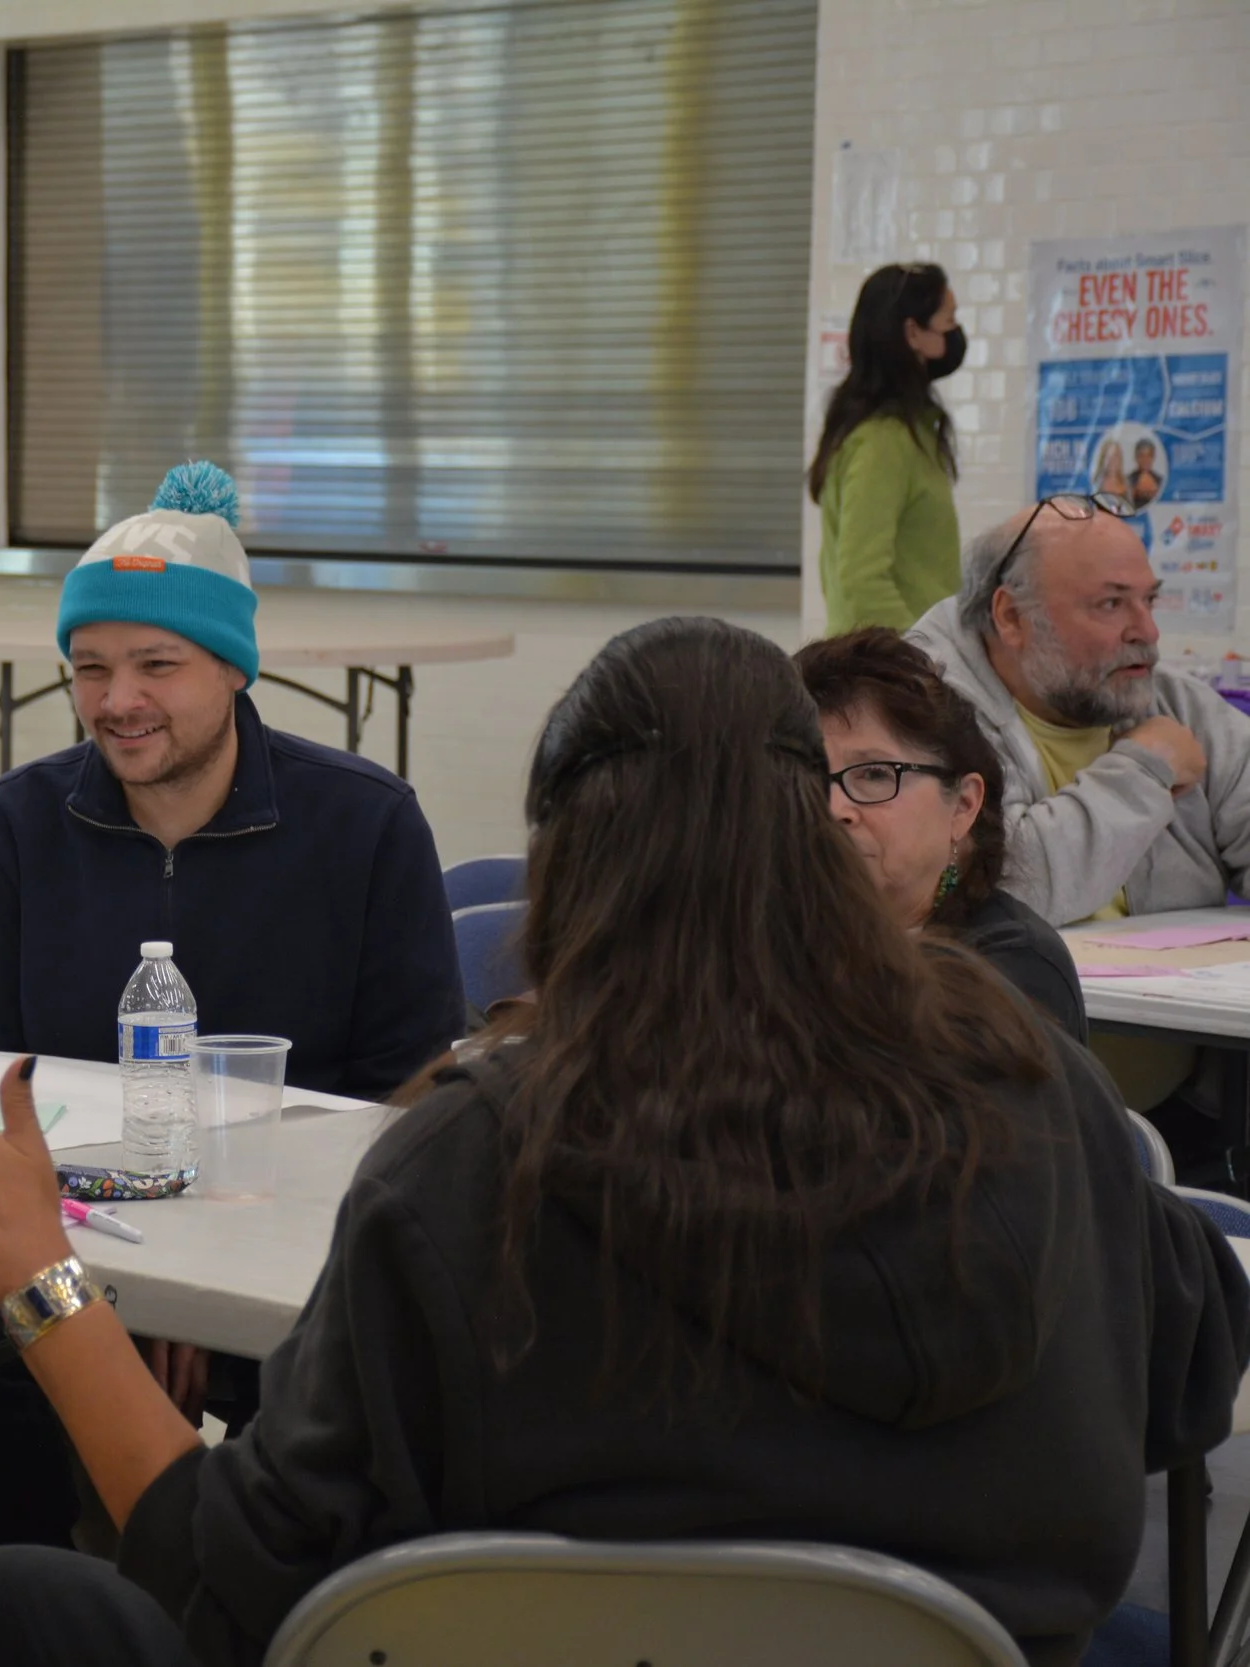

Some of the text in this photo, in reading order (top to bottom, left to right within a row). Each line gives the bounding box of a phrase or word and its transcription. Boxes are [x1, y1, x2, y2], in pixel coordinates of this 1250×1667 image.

[1078, 269, 1190, 308] EVEN THE
[1053, 304, 1215, 345] CHEESY ONES.
